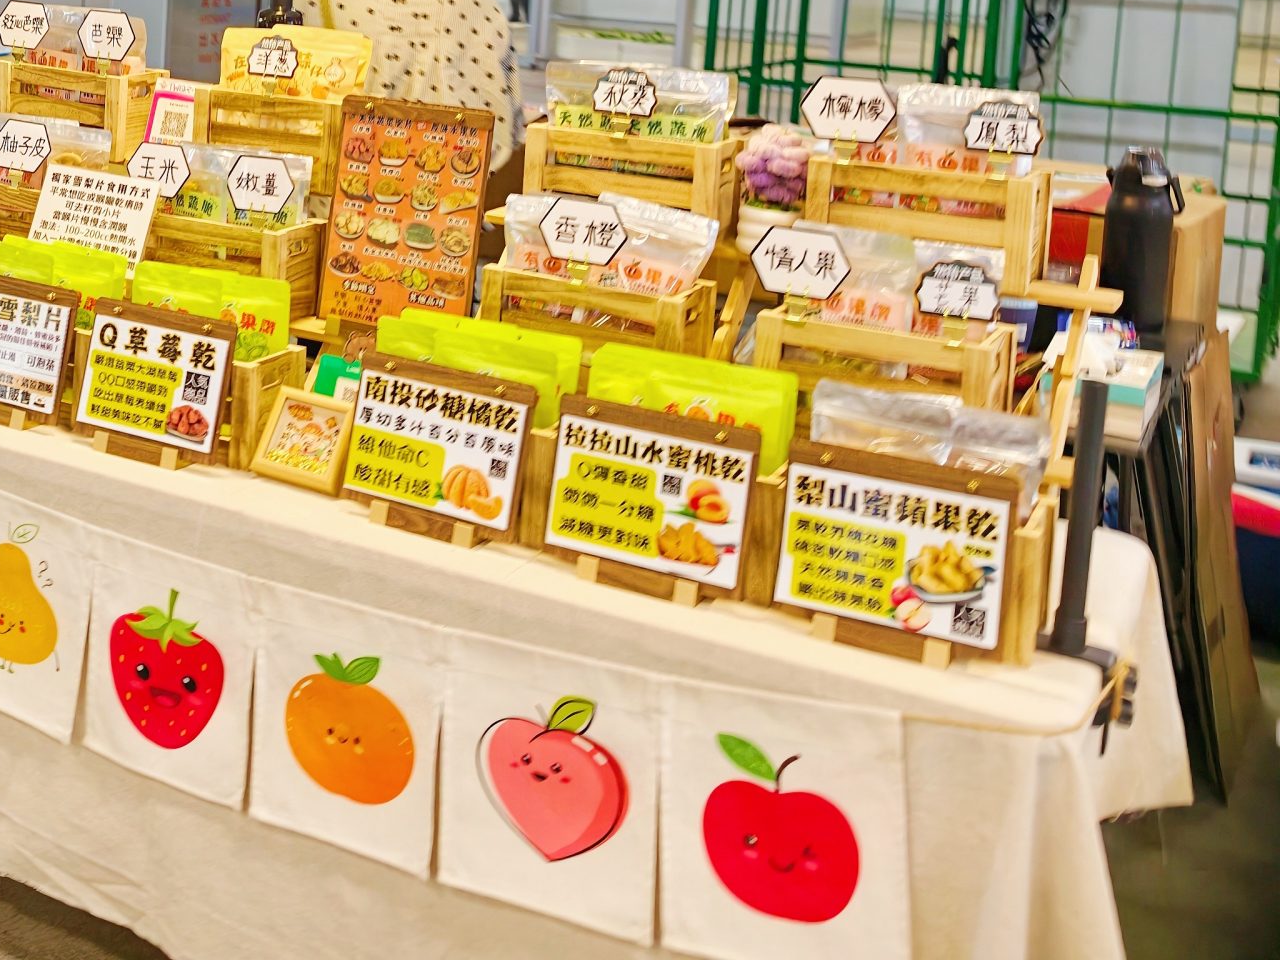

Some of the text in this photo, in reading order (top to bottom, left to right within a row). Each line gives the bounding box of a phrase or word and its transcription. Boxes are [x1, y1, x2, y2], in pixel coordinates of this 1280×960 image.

[92, 24, 123, 48] 芭樂
[819, 92, 886, 122] 檸檬
[0, 132, 46, 159] 柚子皮
[51, 172, 151, 200] 獨家雪梨片食用方式
[136, 155, 179, 184] 玉米
[236, 170, 280, 197] 嫩薑
[554, 216, 617, 249] 香橙
[764, 243, 839, 280] 情人果
[99, 322, 217, 372] Q草莓乾
[365, 376, 519, 434] 南投砂糖橘乾
[359, 406, 515, 459] 厚切多汁百分百原味
[357, 434, 430, 469] 維他命C
[563, 423, 746, 483] 拉拉山水蜜桃乾
[795, 475, 999, 541] 梨山蜜蘋果乾
